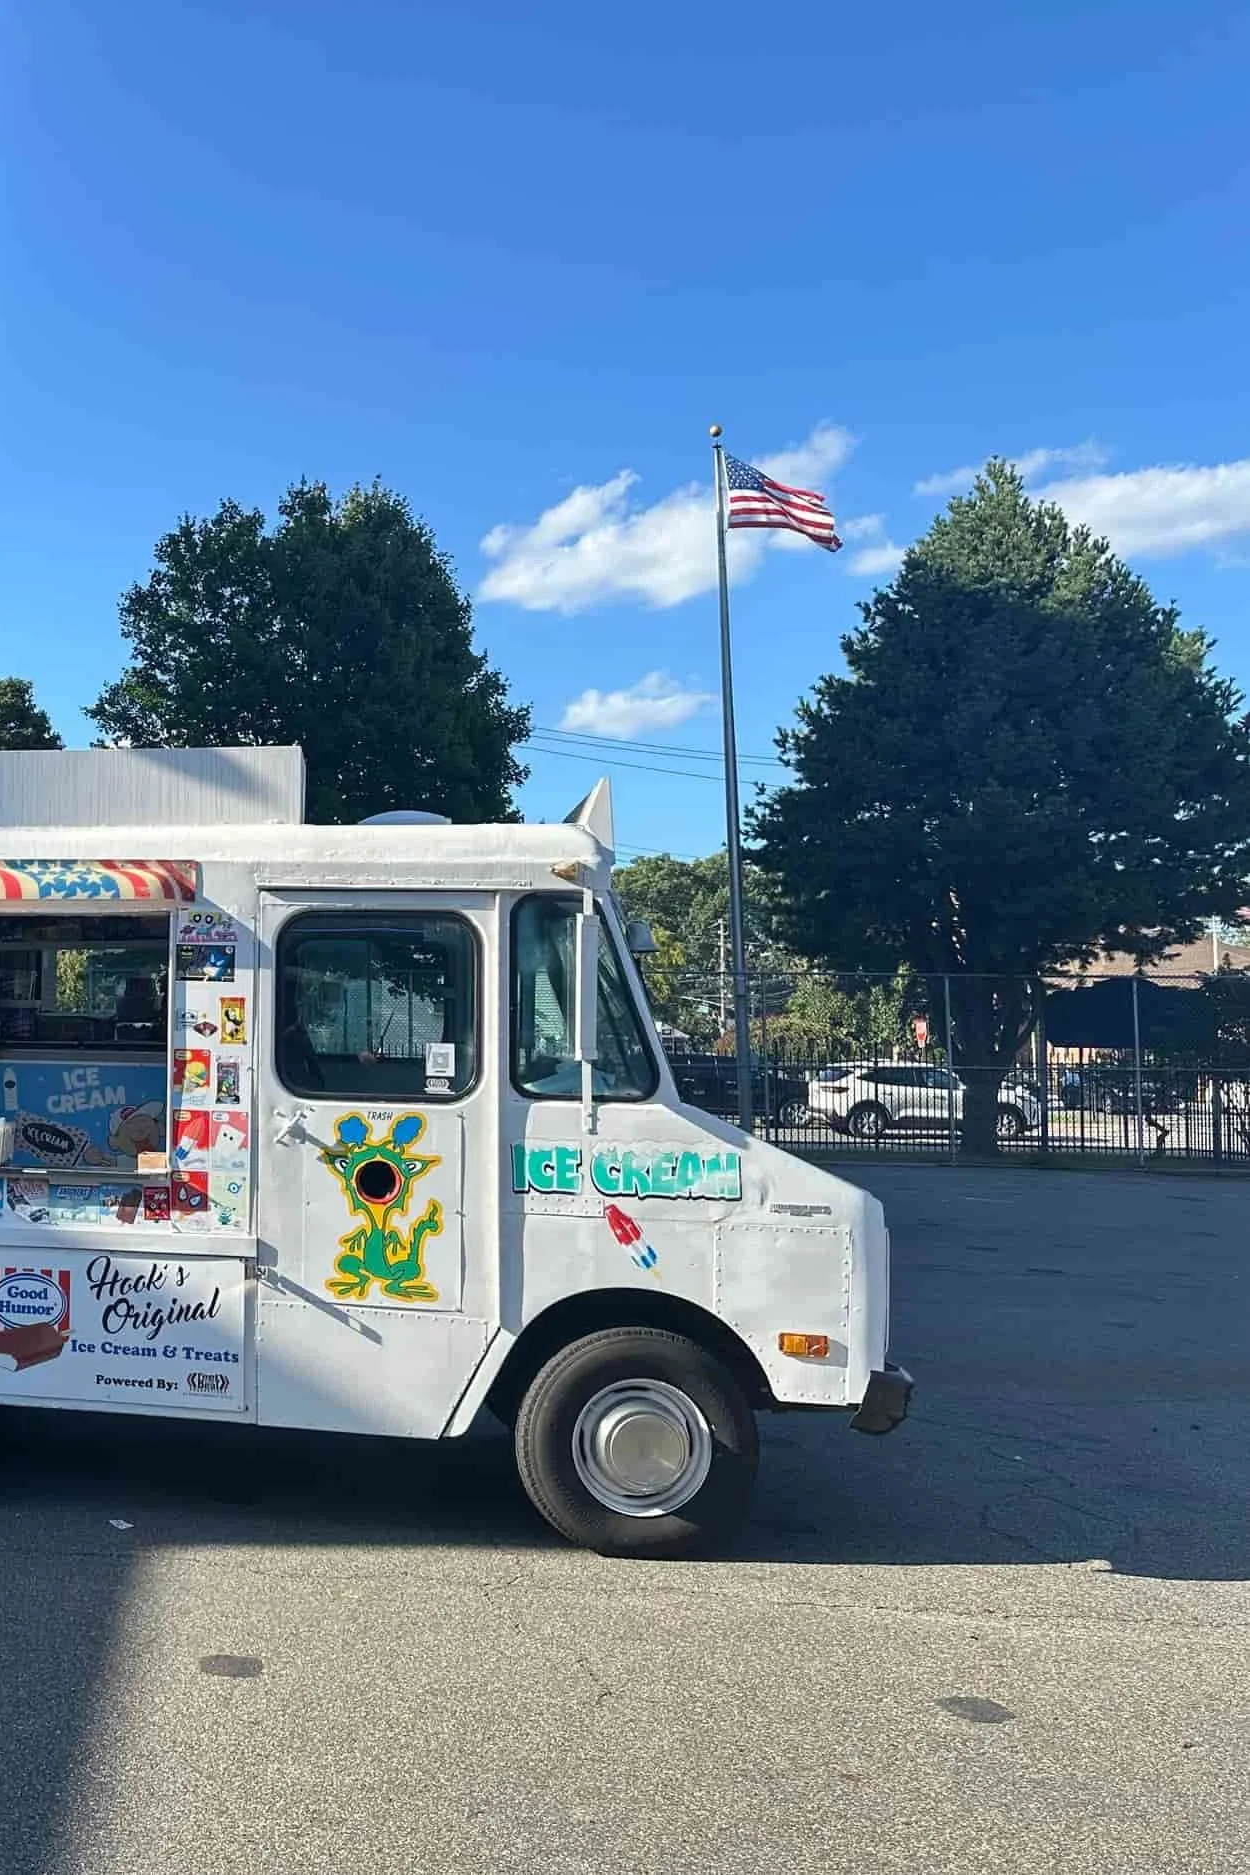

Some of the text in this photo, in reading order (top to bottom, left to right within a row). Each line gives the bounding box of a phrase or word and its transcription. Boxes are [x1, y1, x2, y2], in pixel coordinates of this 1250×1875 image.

[63, 1067, 100, 1090] ICE
[47, 1085, 126, 1113] CREAM
[366, 1111, 393, 1121] TRASH
[512, 1143, 742, 1200] ICE CREAM
[86, 1255, 190, 1300] Hook's
[7, 1286, 48, 1300] Good
[102, 1298, 221, 1340] Original
[70, 1339, 239, 1363] Ice Cream & Treats
[95, 1374, 153, 1389] Powered
[156, 1378, 179, 1391] By:
